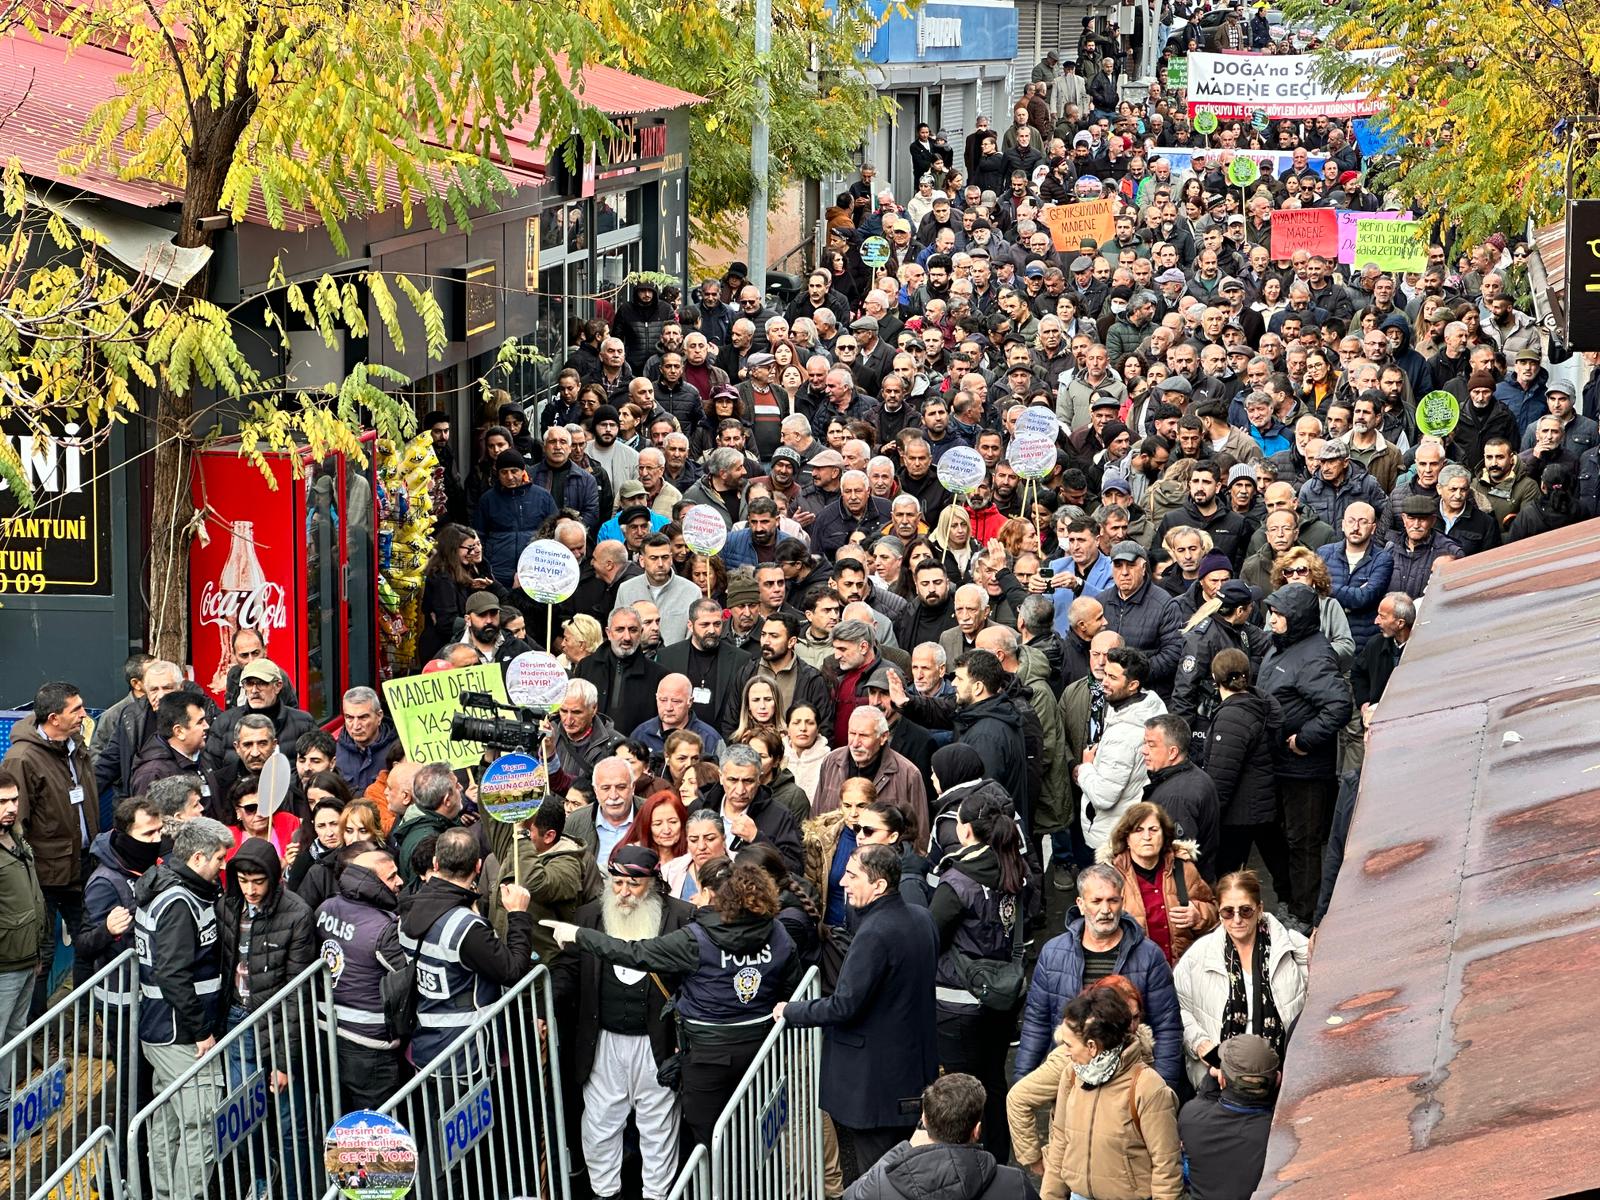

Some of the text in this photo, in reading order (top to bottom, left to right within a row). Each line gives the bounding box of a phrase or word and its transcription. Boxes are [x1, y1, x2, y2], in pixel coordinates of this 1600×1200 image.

[1196, 81, 1269, 97] MADENE
[1234, 104, 1243, 116] VE
[1062, 218, 1097, 234] MADENE
[1286, 225, 1325, 239] MADENE
[534, 556, 566, 567] Barajlara
[535, 548, 571, 560] Dersim'de
[533, 565, 563, 577] HAYIR!
[15, 573, 46, 594] 09
[200, 580, 287, 629] Coca-Cola
[520, 661, 557, 669] Dersim'de
[521, 679, 551, 687] HAYIR!
[388, 677, 444, 710] MADEN
[501, 763, 527, 773] Yaşam
[316, 911, 356, 942] POLİS
[215, 1080, 267, 1154] POLİS
[444, 1087, 492, 1162] POLİS
[335, 1126, 391, 1137] Dersim'de
[339, 1148, 414, 1165] GEÇİT YOK!
